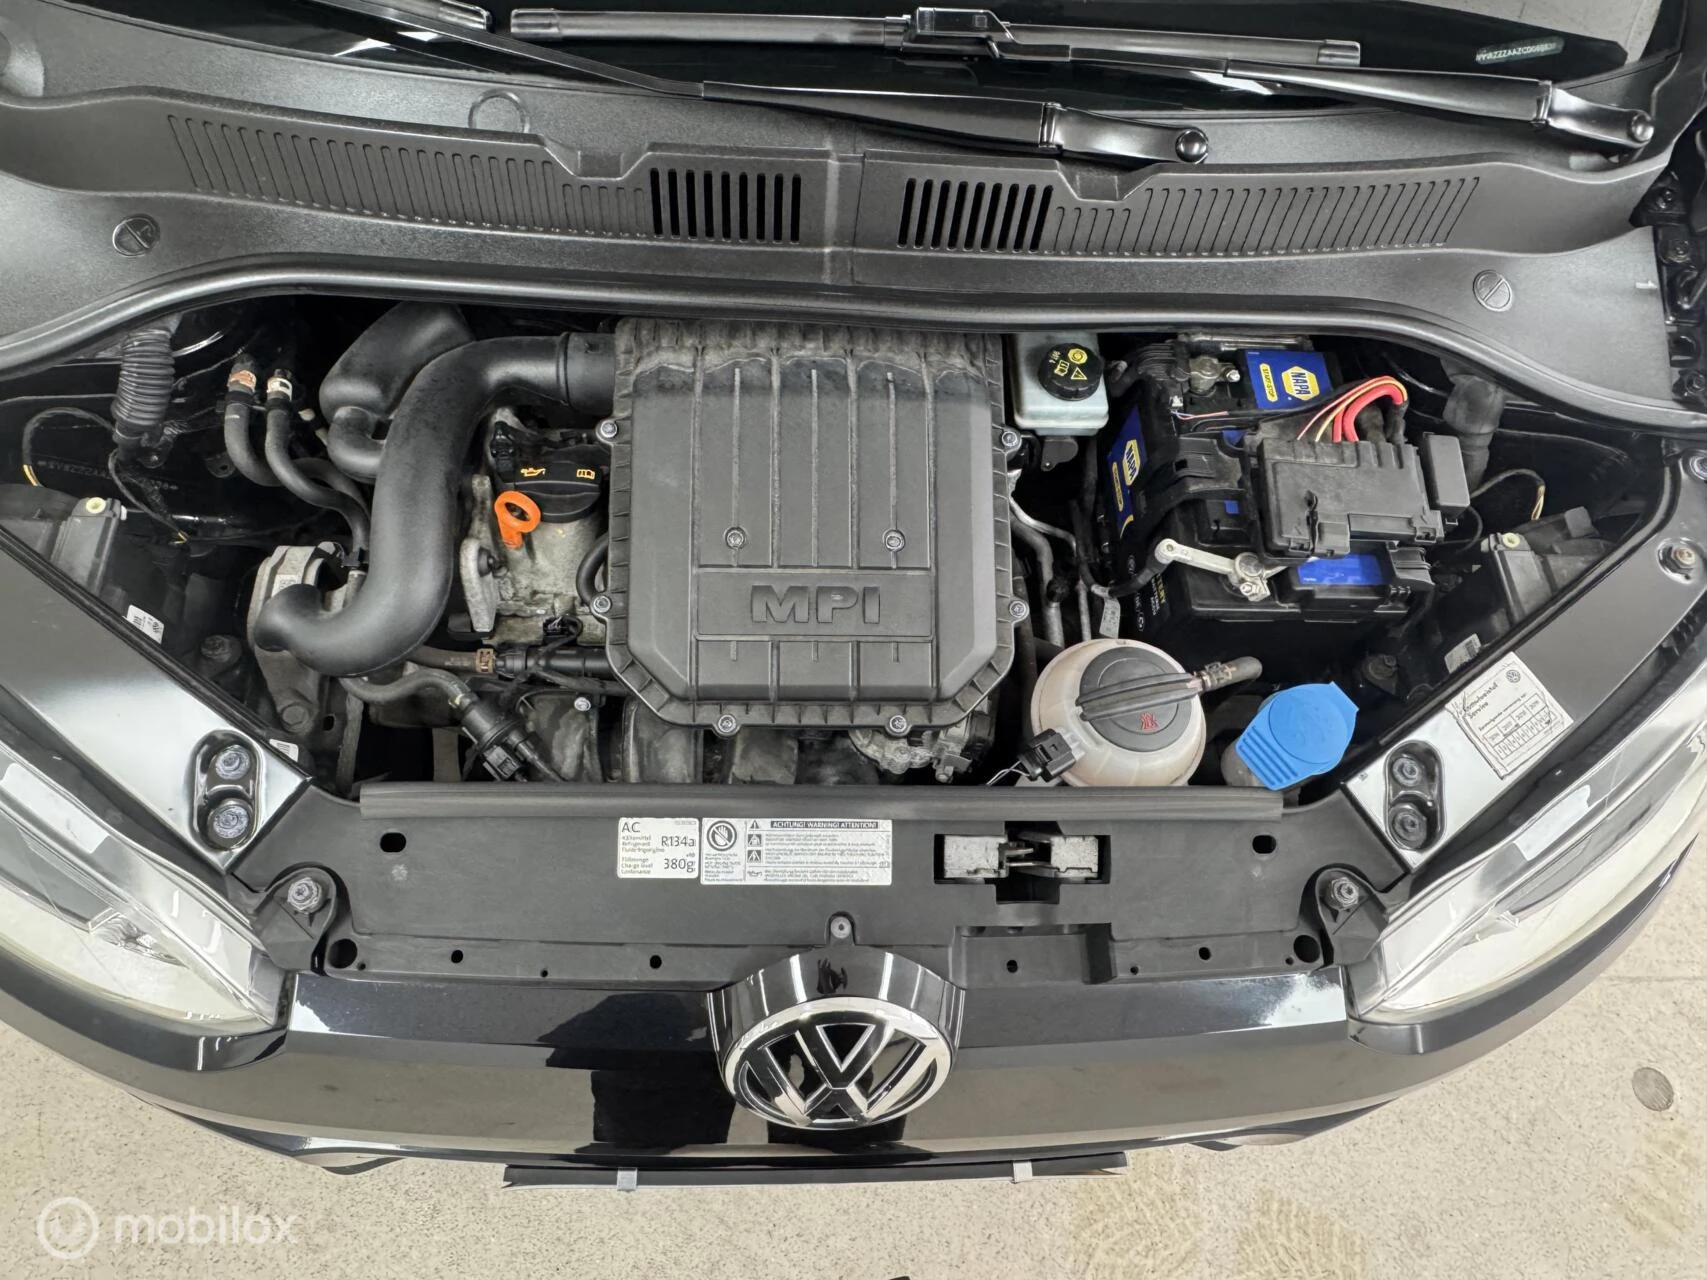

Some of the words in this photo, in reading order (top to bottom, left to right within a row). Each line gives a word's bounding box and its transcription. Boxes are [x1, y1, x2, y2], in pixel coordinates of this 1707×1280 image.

[1291, 371, 1311, 395] NAPA
[751, 585, 881, 624] MPI
[622, 822, 641, 832] AC
[661, 836, 696, 847] R134a
[664, 858, 696, 873] 380g
